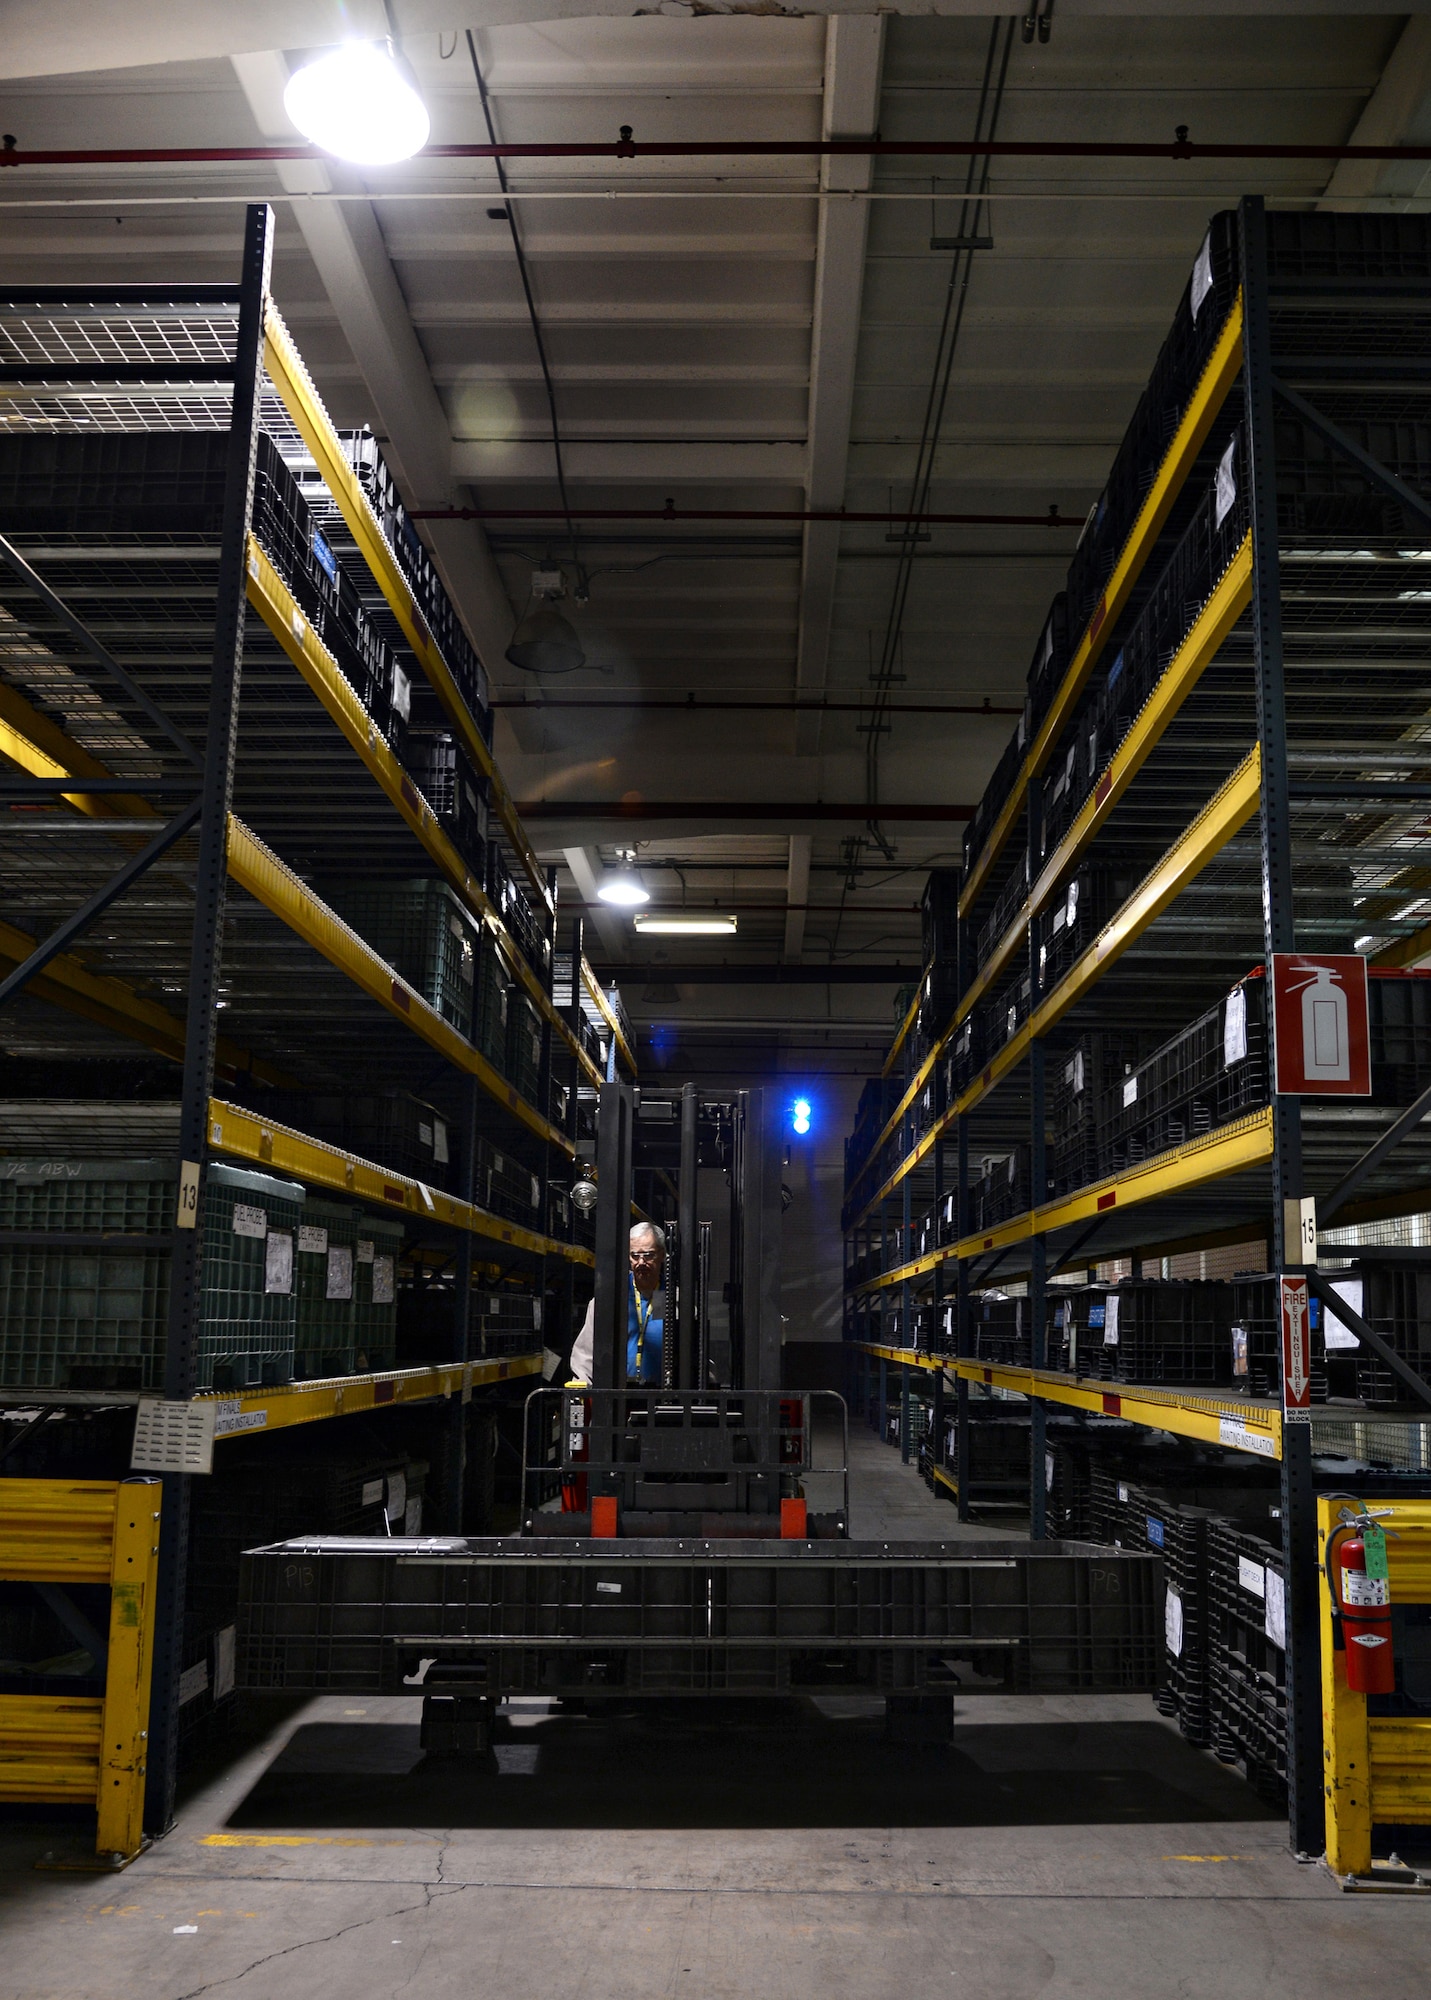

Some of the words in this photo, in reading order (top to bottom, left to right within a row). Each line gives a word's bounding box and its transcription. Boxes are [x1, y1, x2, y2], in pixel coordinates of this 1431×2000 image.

[38, 1162, 82, 1176] ABW
[183, 1183, 196, 1210] 13
[247, 1206, 262, 1225] PROBE
[308, 1227, 323, 1242] PROBE
[1302, 1218, 1314, 1243] 15
[1284, 1293, 1305, 1305] FIRE
[1293, 1305, 1301, 1396] EXTINGUISHER
[235, 1412, 267, 1430] INSTALLATION
[1241, 1433, 1274, 1455] INSTALLATION
